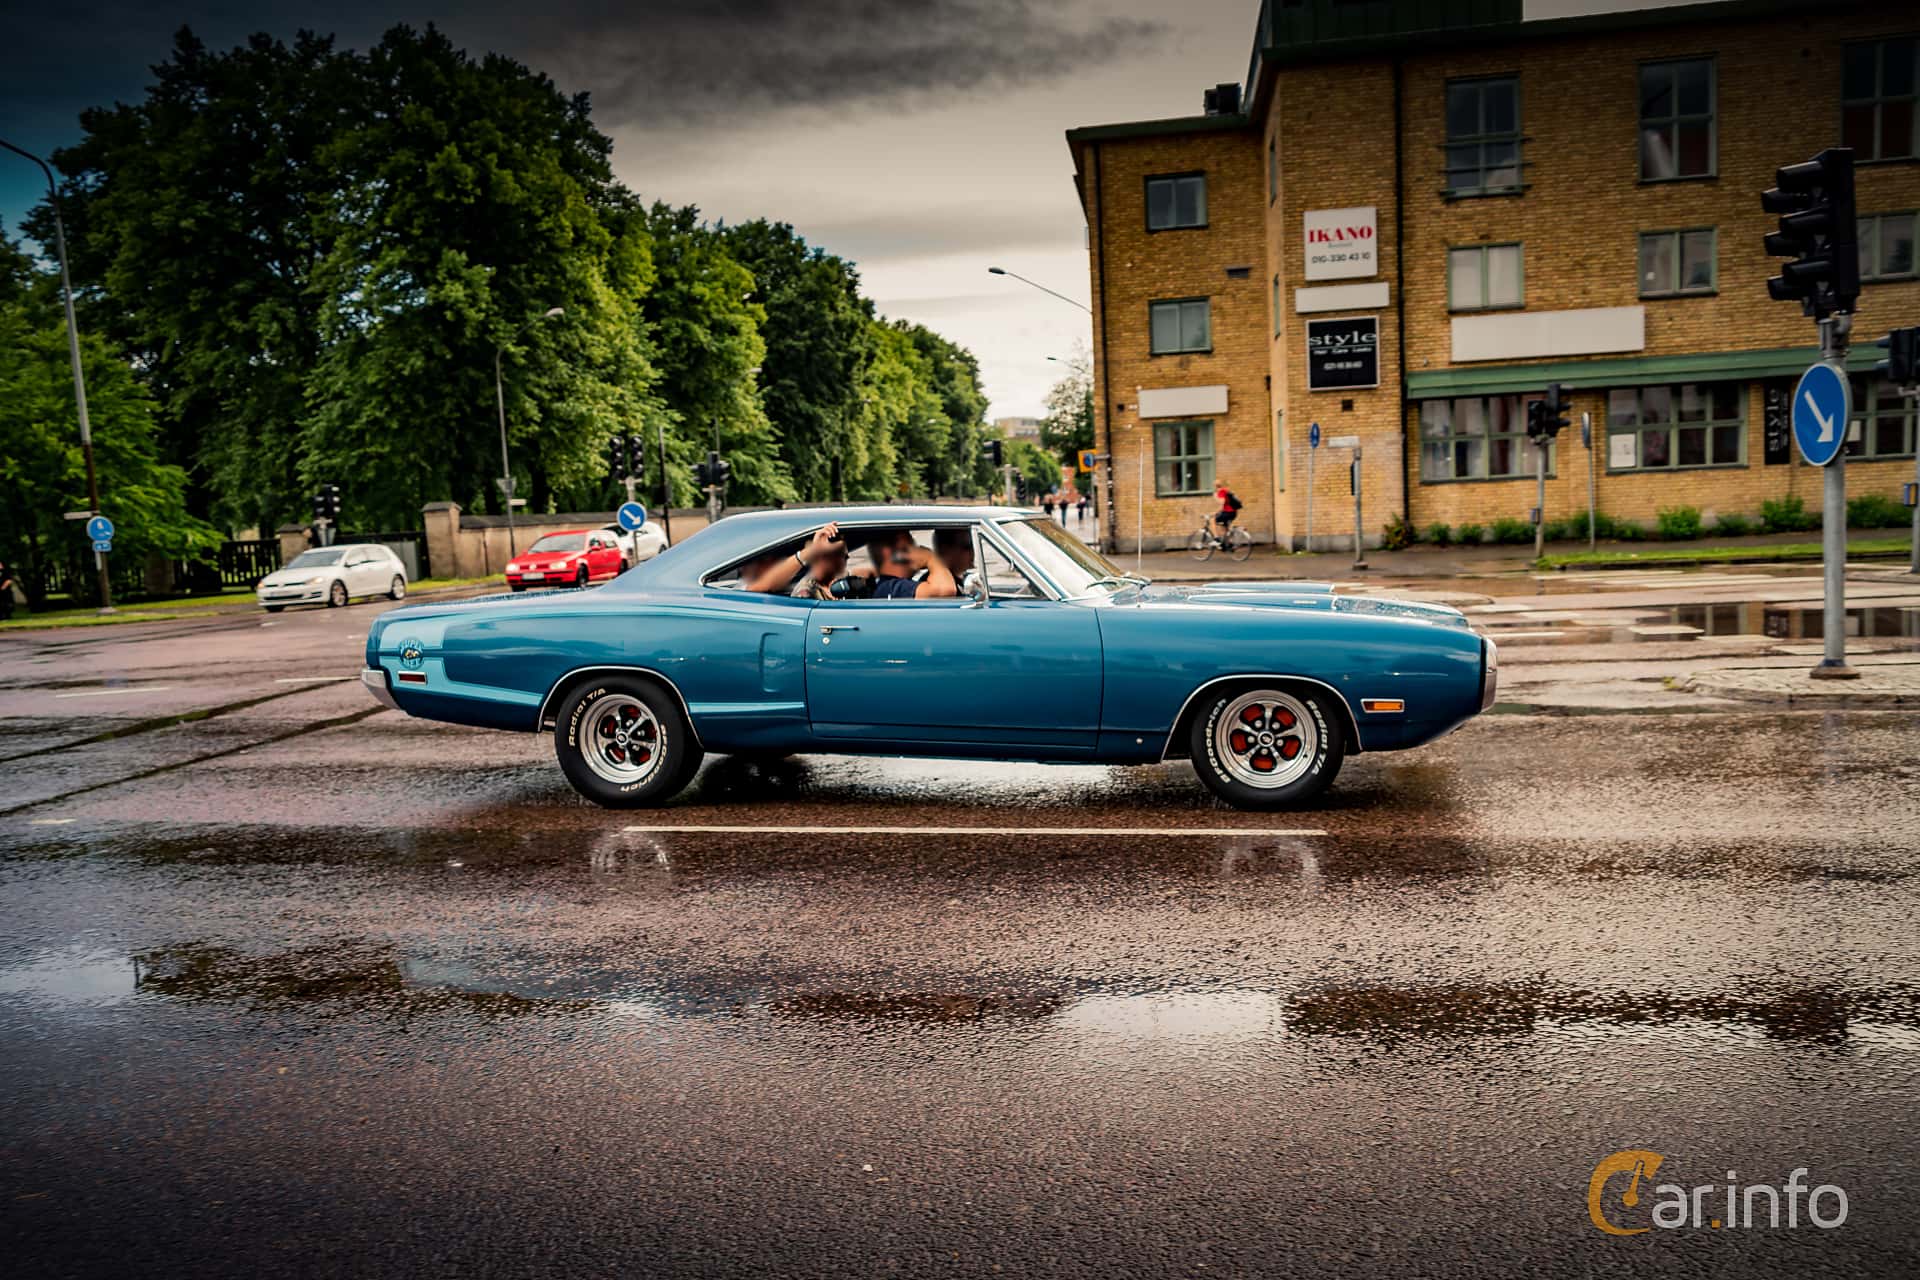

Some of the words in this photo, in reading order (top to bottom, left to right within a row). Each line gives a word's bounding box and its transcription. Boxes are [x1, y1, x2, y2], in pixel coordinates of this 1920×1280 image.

[1308, 226, 1373, 243] IKANO
[1309, 330, 1377, 347] style
[1766, 389, 1781, 452] style
[568, 700, 587, 747] Radial
[586, 687, 606, 701] T/A
[1306, 699, 1329, 750] Radial
[1311, 753, 1327, 775] T/A
